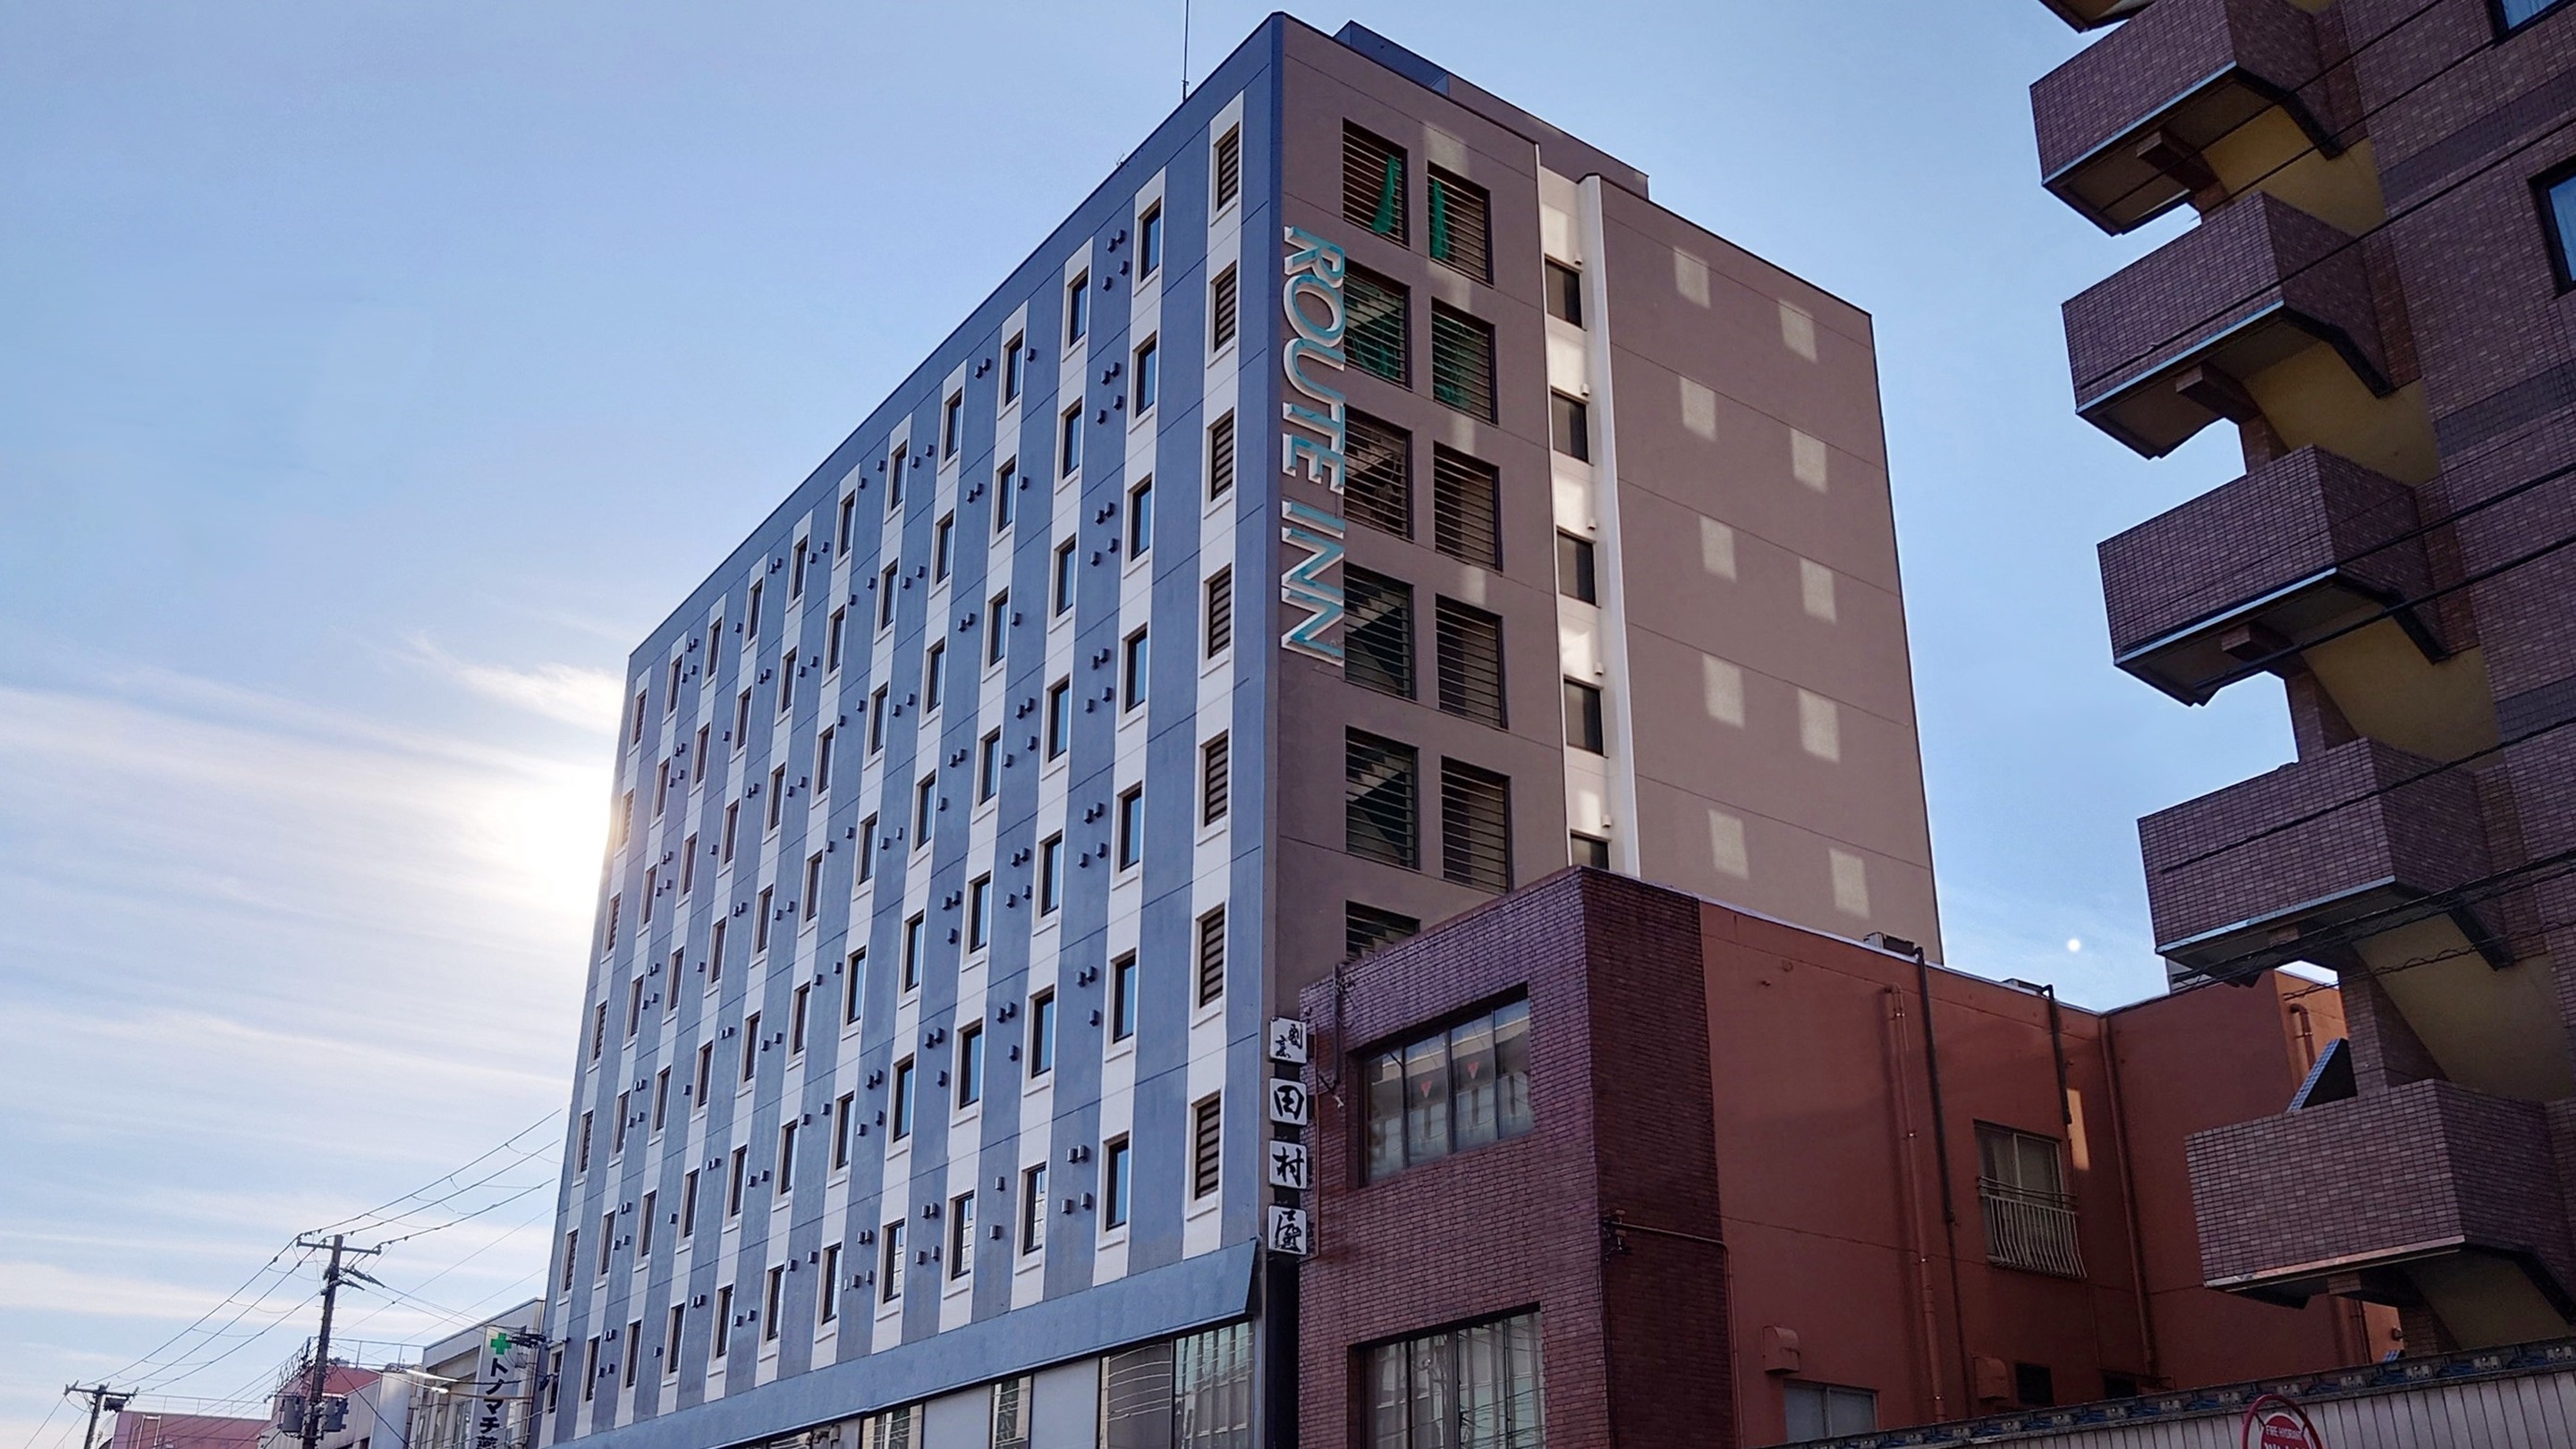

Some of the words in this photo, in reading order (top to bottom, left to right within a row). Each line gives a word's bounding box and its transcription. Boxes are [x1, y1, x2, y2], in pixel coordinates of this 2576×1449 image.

[1283, 225, 1346, 496] ROUTE
[1281, 500, 1345, 667] INN
[1273, 1084, 1305, 1253] 田村屋
